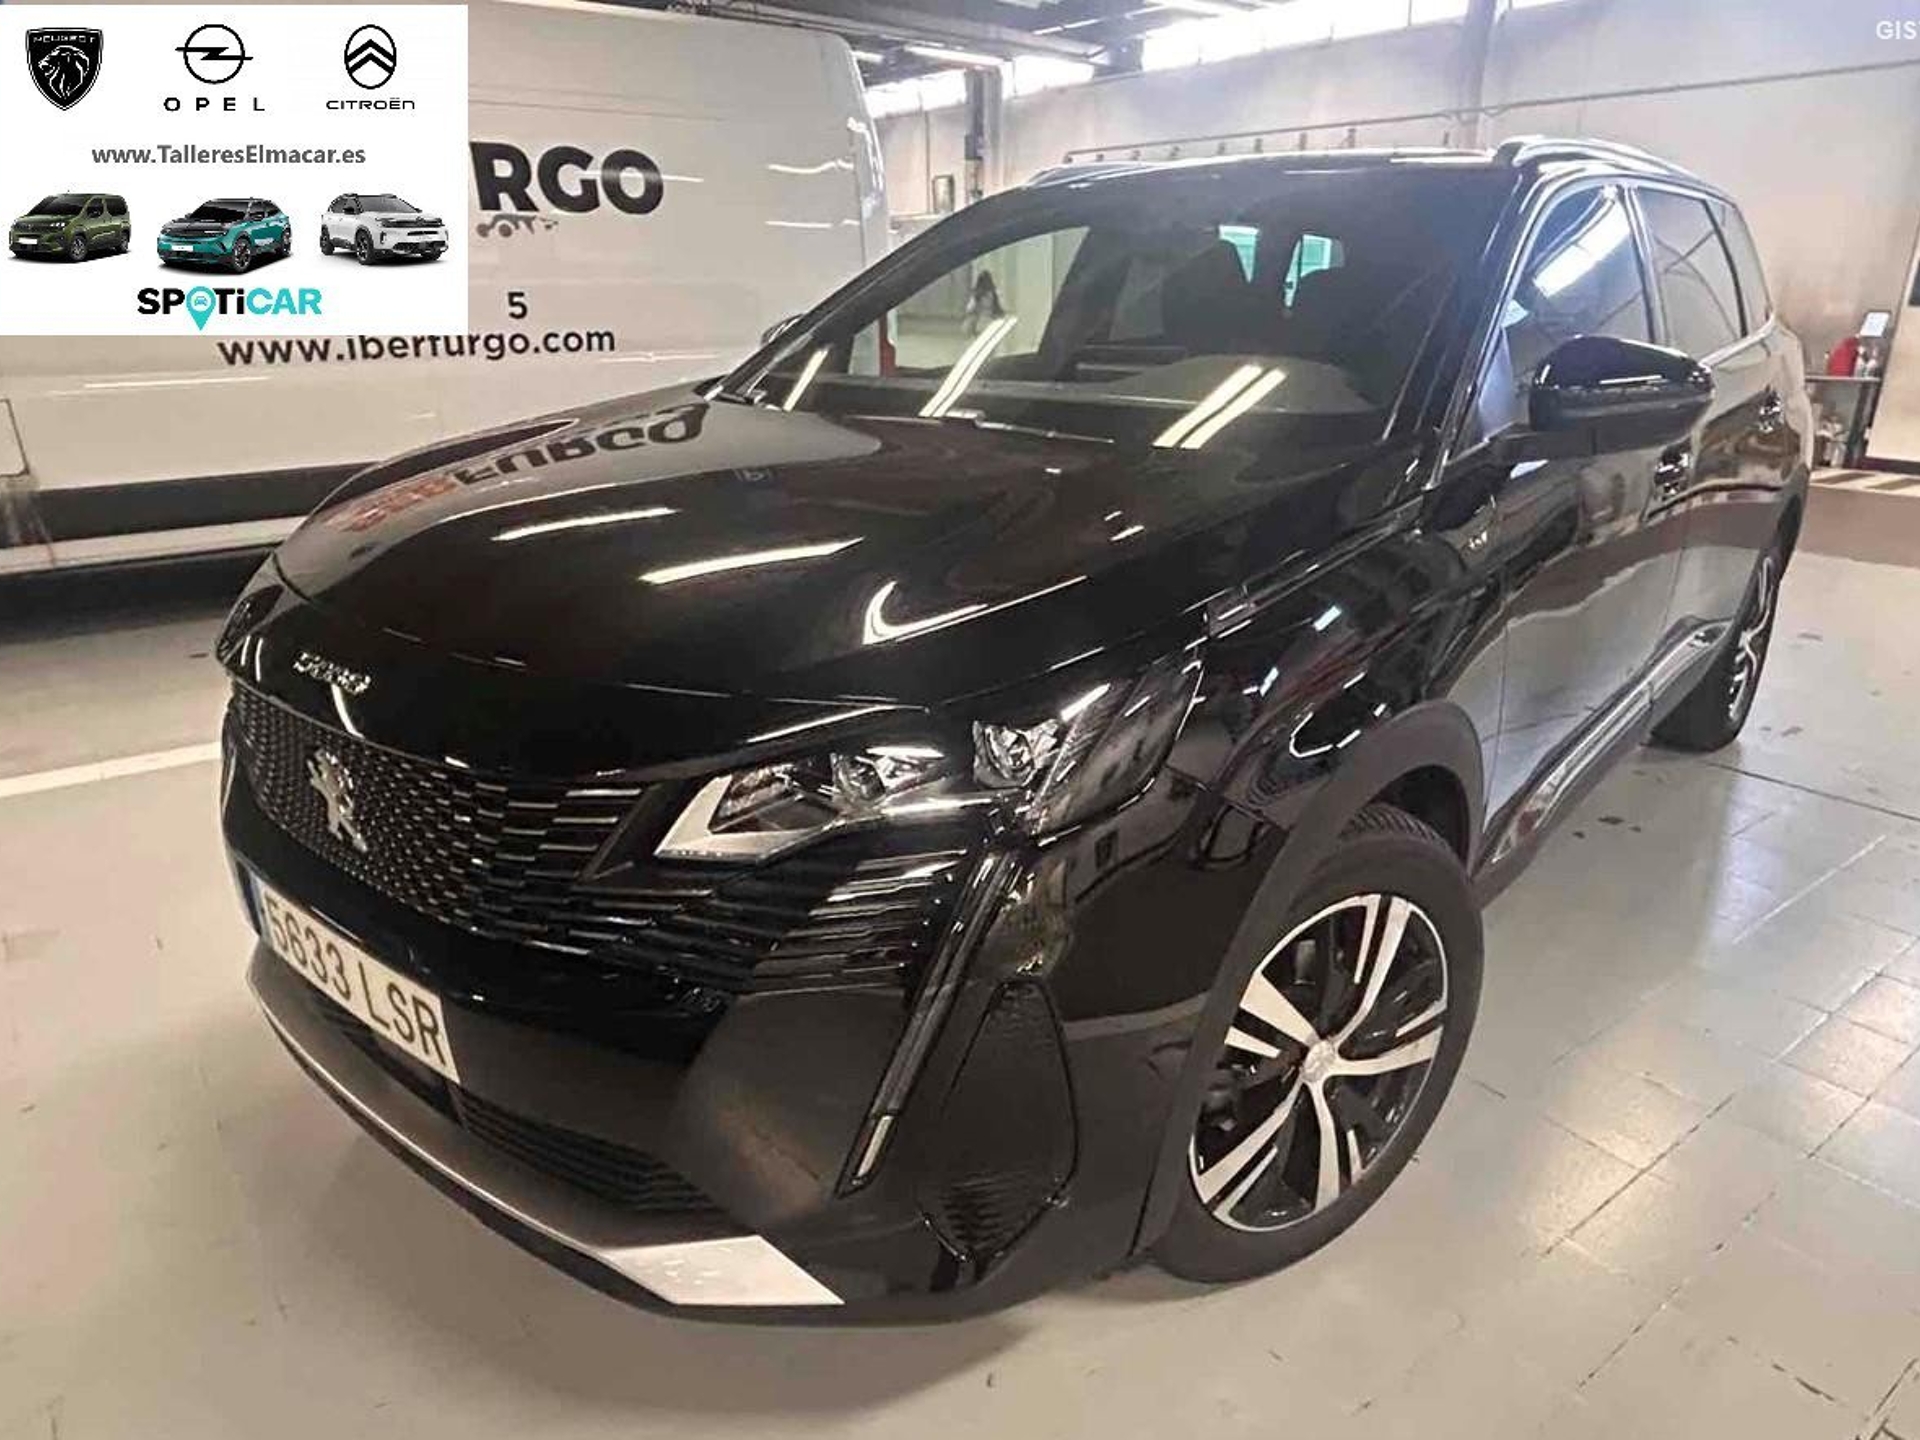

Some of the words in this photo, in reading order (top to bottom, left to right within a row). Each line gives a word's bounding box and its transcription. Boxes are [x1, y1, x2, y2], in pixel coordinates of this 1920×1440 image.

[507, 291, 528, 320] 5
[217, 330, 616, 366] www.iberfurgo.com
[263, 891, 351, 1002] 5633
[359, 961, 447, 1067] LSR
